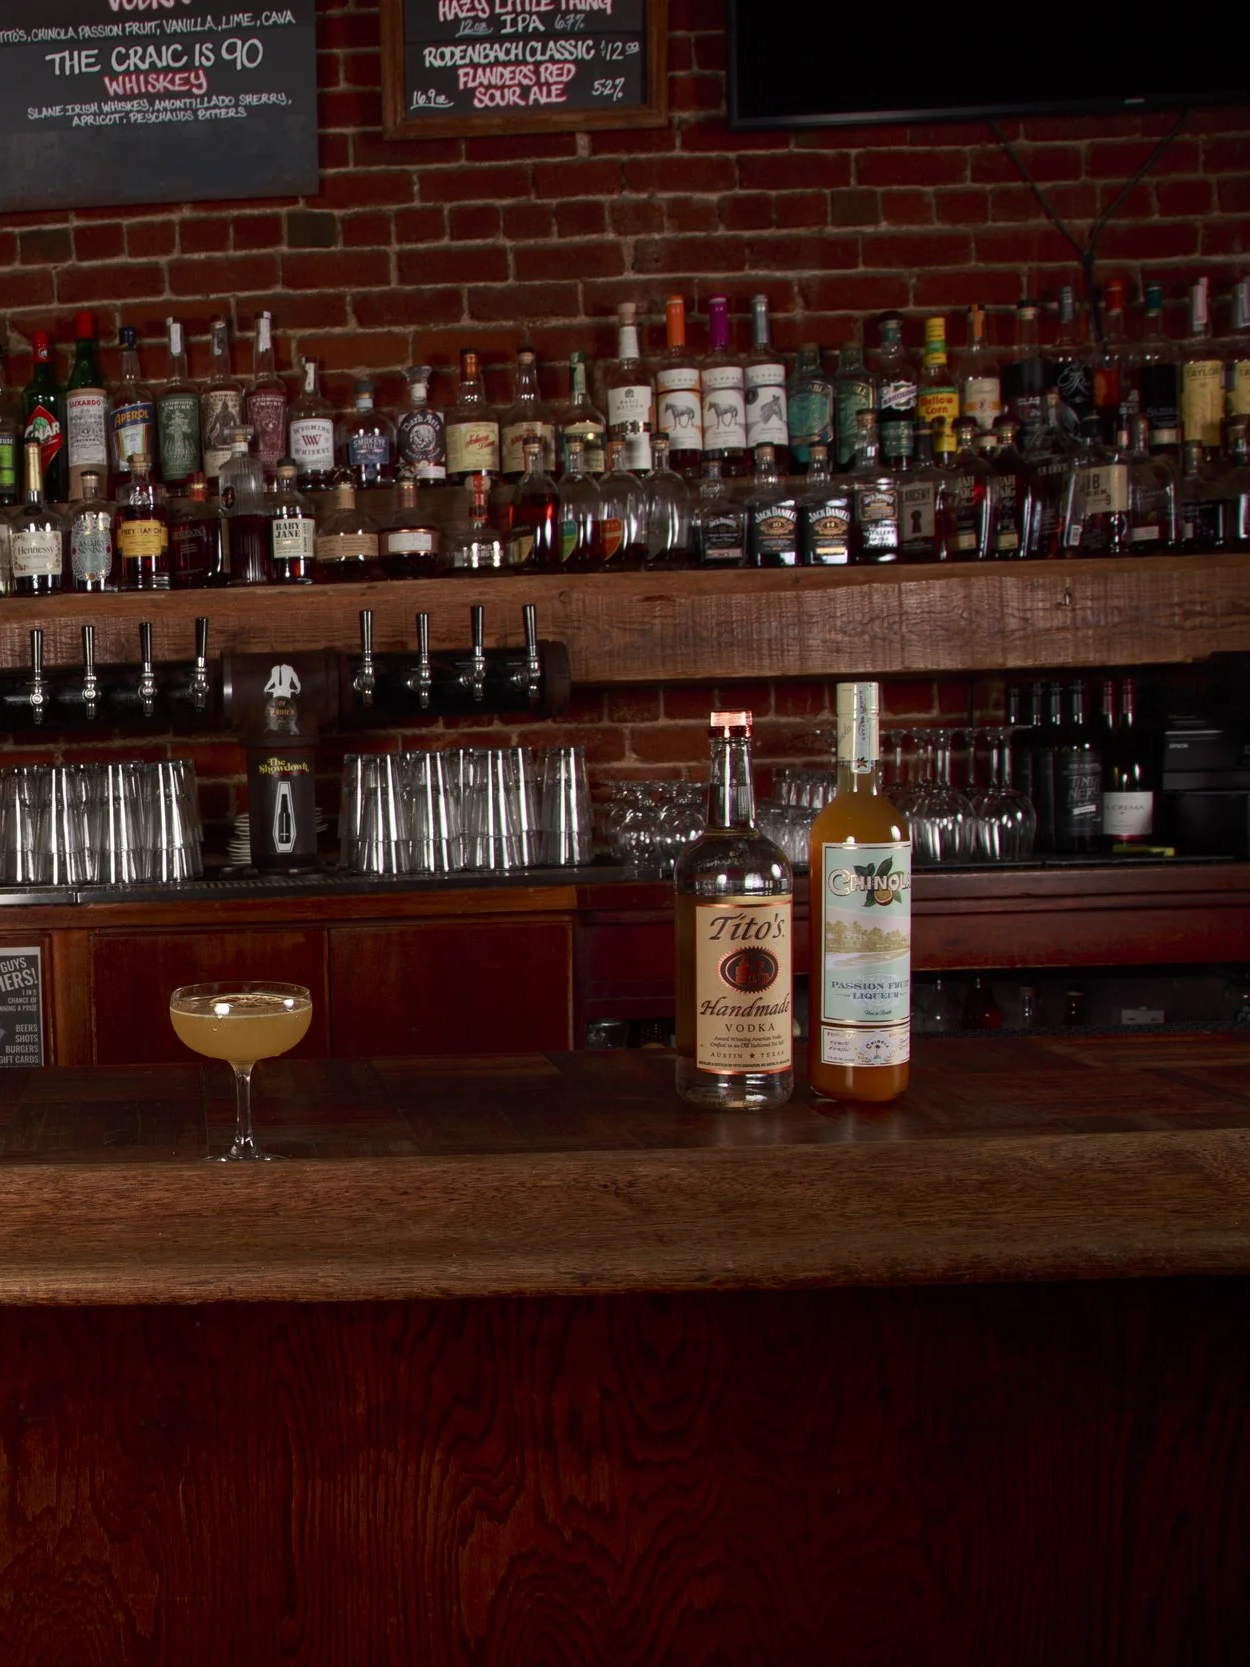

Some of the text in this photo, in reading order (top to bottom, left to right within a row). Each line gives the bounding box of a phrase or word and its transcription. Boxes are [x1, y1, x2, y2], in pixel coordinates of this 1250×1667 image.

[31, 9, 297, 42] CHINOLA PASSION CAVA
[500, 14, 546, 34] IPA
[45, 37, 263, 76] THE CRAIC IS 90
[423, 39, 595, 68] RODENBACH CLASSIC
[103, 68, 208, 97] WHISKEY
[457, 63, 577, 90] FLANDERS RED
[473, 84, 567, 108] SOUR ALE
[27, 95, 235, 120] SLANE IRISH AMONTILLADO
[198, 107, 247, 120] BITTERS
[70, 399, 102, 408] LUXARDO
[114, 408, 150, 428] APEROL
[292, 424, 331, 434] WYOMING
[276, 530, 301, 538] JANE
[708, 912, 785, 941] Tito's
[0, 957, 27, 973] GUYS
[831, 980, 884, 990] PASSION
[852, 991, 900, 1000] LIQUEUR
[700, 993, 790, 1018] Handmade
[16, 1024, 38, 1033] BEERS
[725, 1023, 775, 1033] VODKA
[15, 1034, 38, 1043] SHOTS
[5, 1045, 39, 1054] BURGERS
[15, 1055, 39, 1064] CARDS
